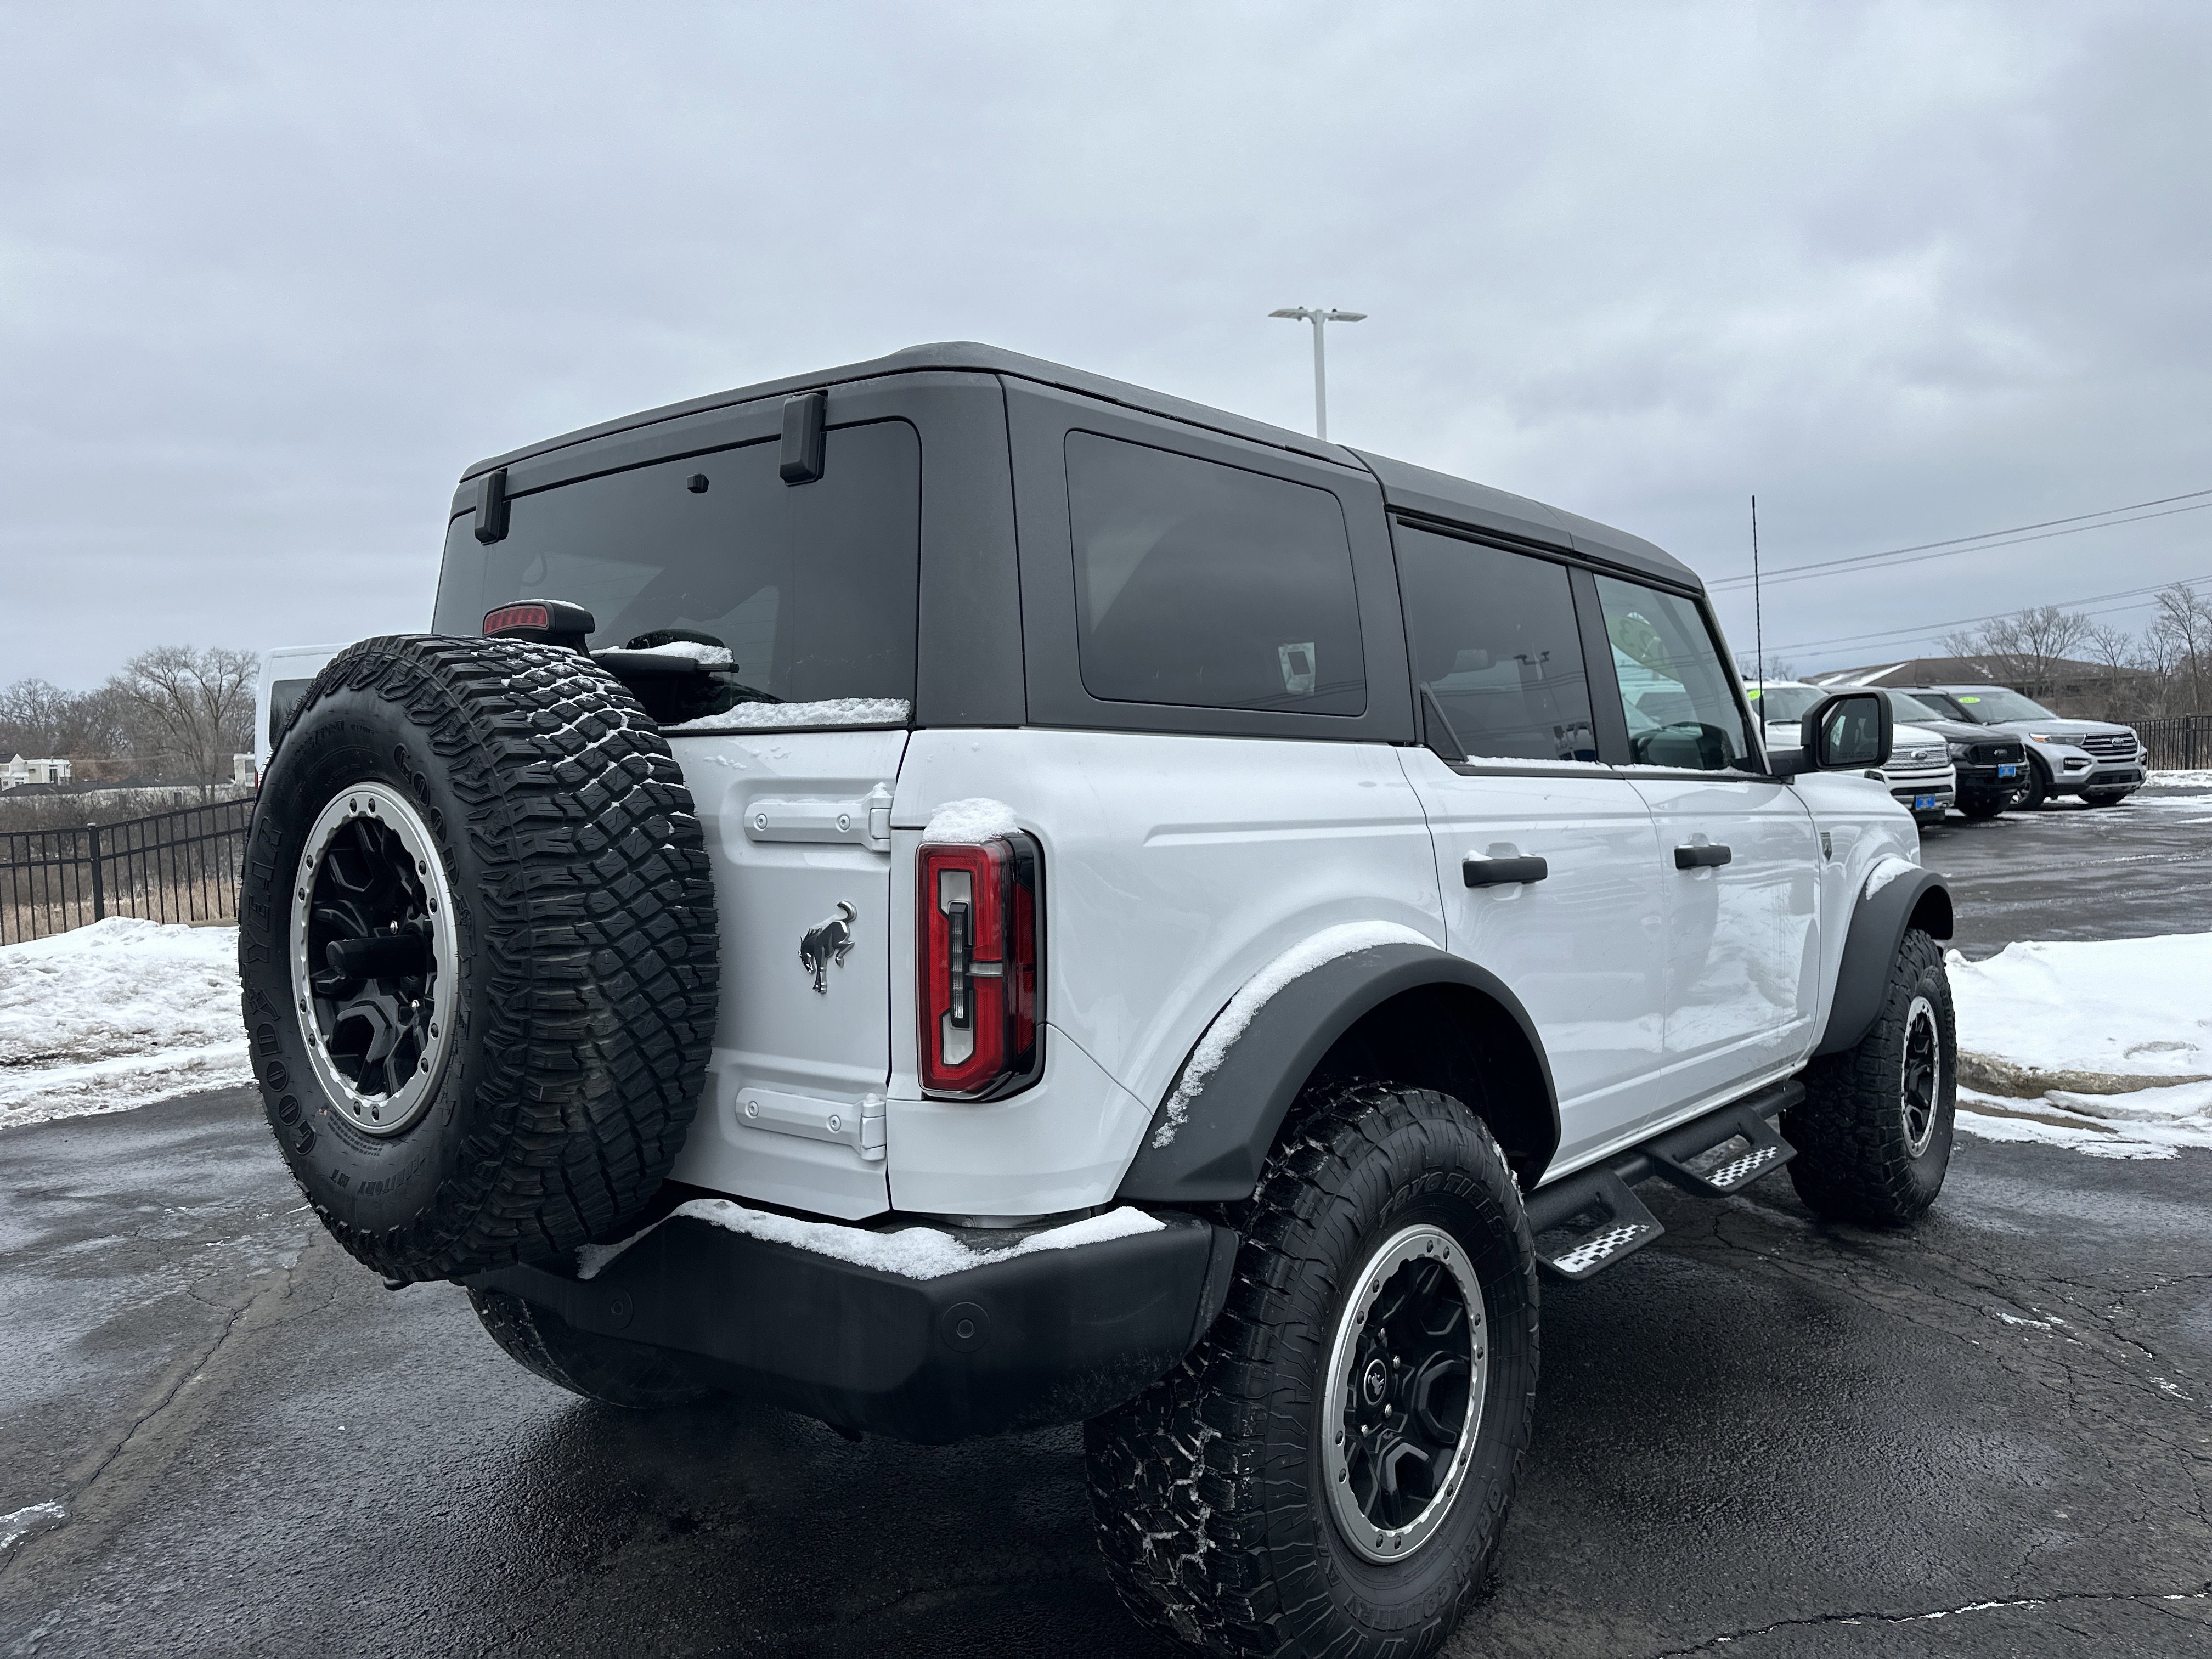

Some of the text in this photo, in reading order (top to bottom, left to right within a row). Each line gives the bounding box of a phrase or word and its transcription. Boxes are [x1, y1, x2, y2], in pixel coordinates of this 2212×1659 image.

[244, 816, 317, 1156] GOODYEAR
[329, 1154, 426, 1196] TERRITORY MT
[1379, 1172, 1508, 1238] TOYO TIRES
[1454, 1479, 1501, 1584] OPEN
[1344, 1576, 1452, 1632] COUNTRY
